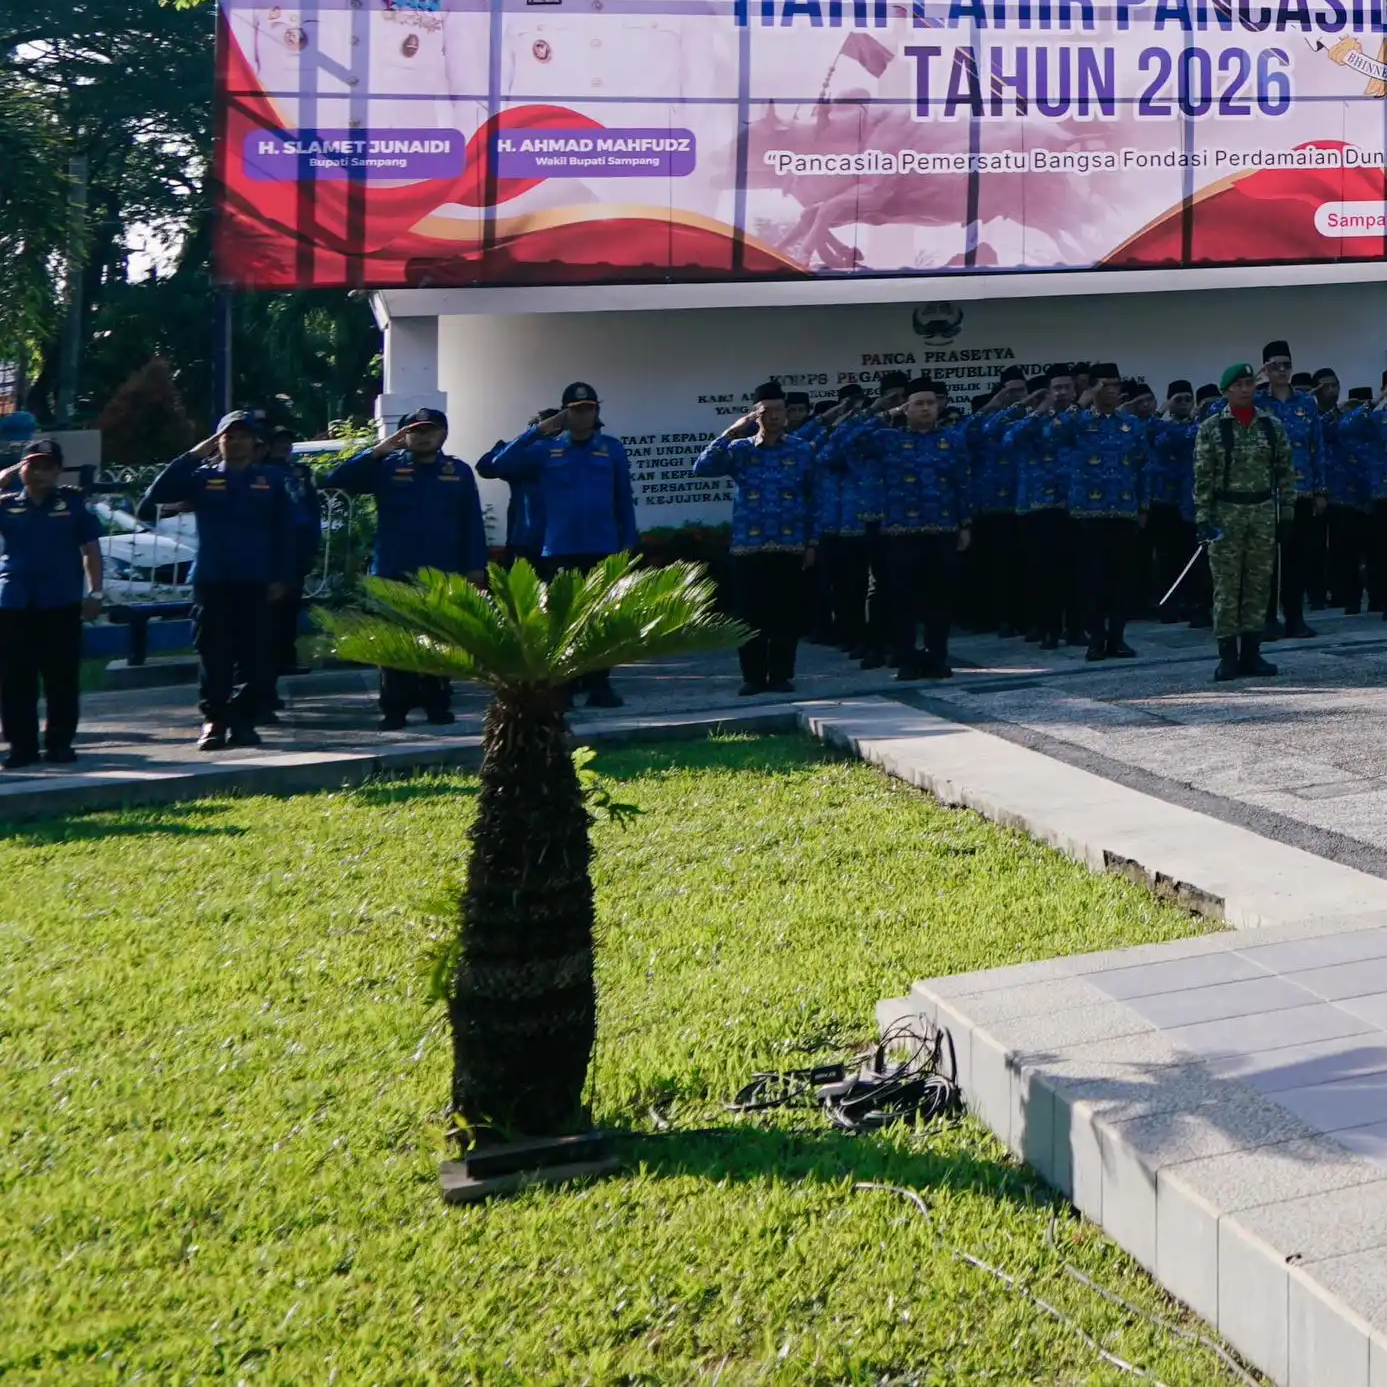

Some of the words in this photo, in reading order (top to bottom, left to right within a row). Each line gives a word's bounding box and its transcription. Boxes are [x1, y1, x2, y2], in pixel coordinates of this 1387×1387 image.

[904, 45, 1115, 118] TAHUN
[1138, 46, 1291, 117] 2026
[257, 140, 279, 154] H.
[284, 140, 365, 154] SLAMET
[369, 140, 450, 154] JUNAIDI
[497, 139, 516, 152] H.
[519, 139, 593, 152] AHMAD
[597, 138, 691, 152] MAHFUDZ
[309, 157, 349, 168] Bupati
[351, 157, 407, 168] Sampang
[536, 156, 567, 166] Wakil
[569, 156, 606, 167] Bupati
[608, 156, 660, 167] Sampang
[902, 151, 1026, 170] Pemersatu
[1034, 151, 1116, 172] Bangsa
[1124, 149, 1208, 168] Fondasi
[1215, 148, 1338, 167] Perdamaian
[862, 352, 916, 366] PANCA
[925, 347, 1015, 363] PRASETYA
[620, 435, 656, 445] TAAT
[660, 432, 716, 444] KEPADA
[637, 457, 684, 468] TINGGI
[641, 479, 720, 493] PERSATUAN
